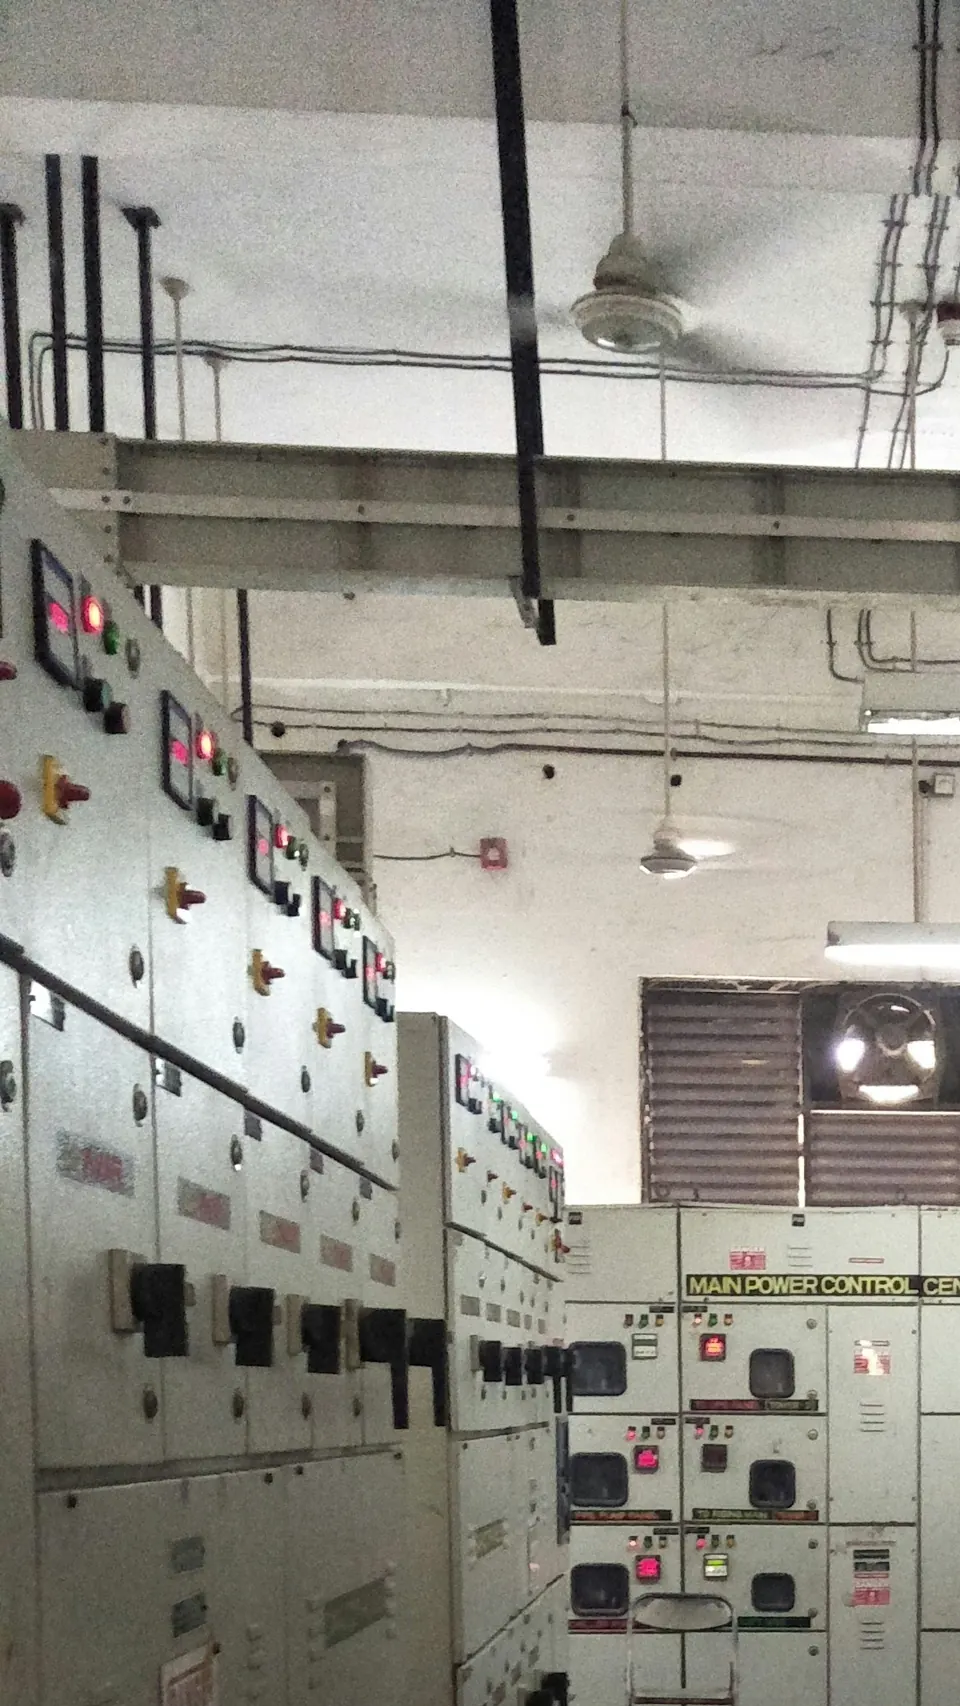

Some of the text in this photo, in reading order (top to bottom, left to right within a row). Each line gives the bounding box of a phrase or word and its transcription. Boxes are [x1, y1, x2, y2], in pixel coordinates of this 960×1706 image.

[689, 1276, 742, 1295] MAIN
[745, 1276, 818, 1295] POWER
[821, 1276, 919, 1295] CONTROL
